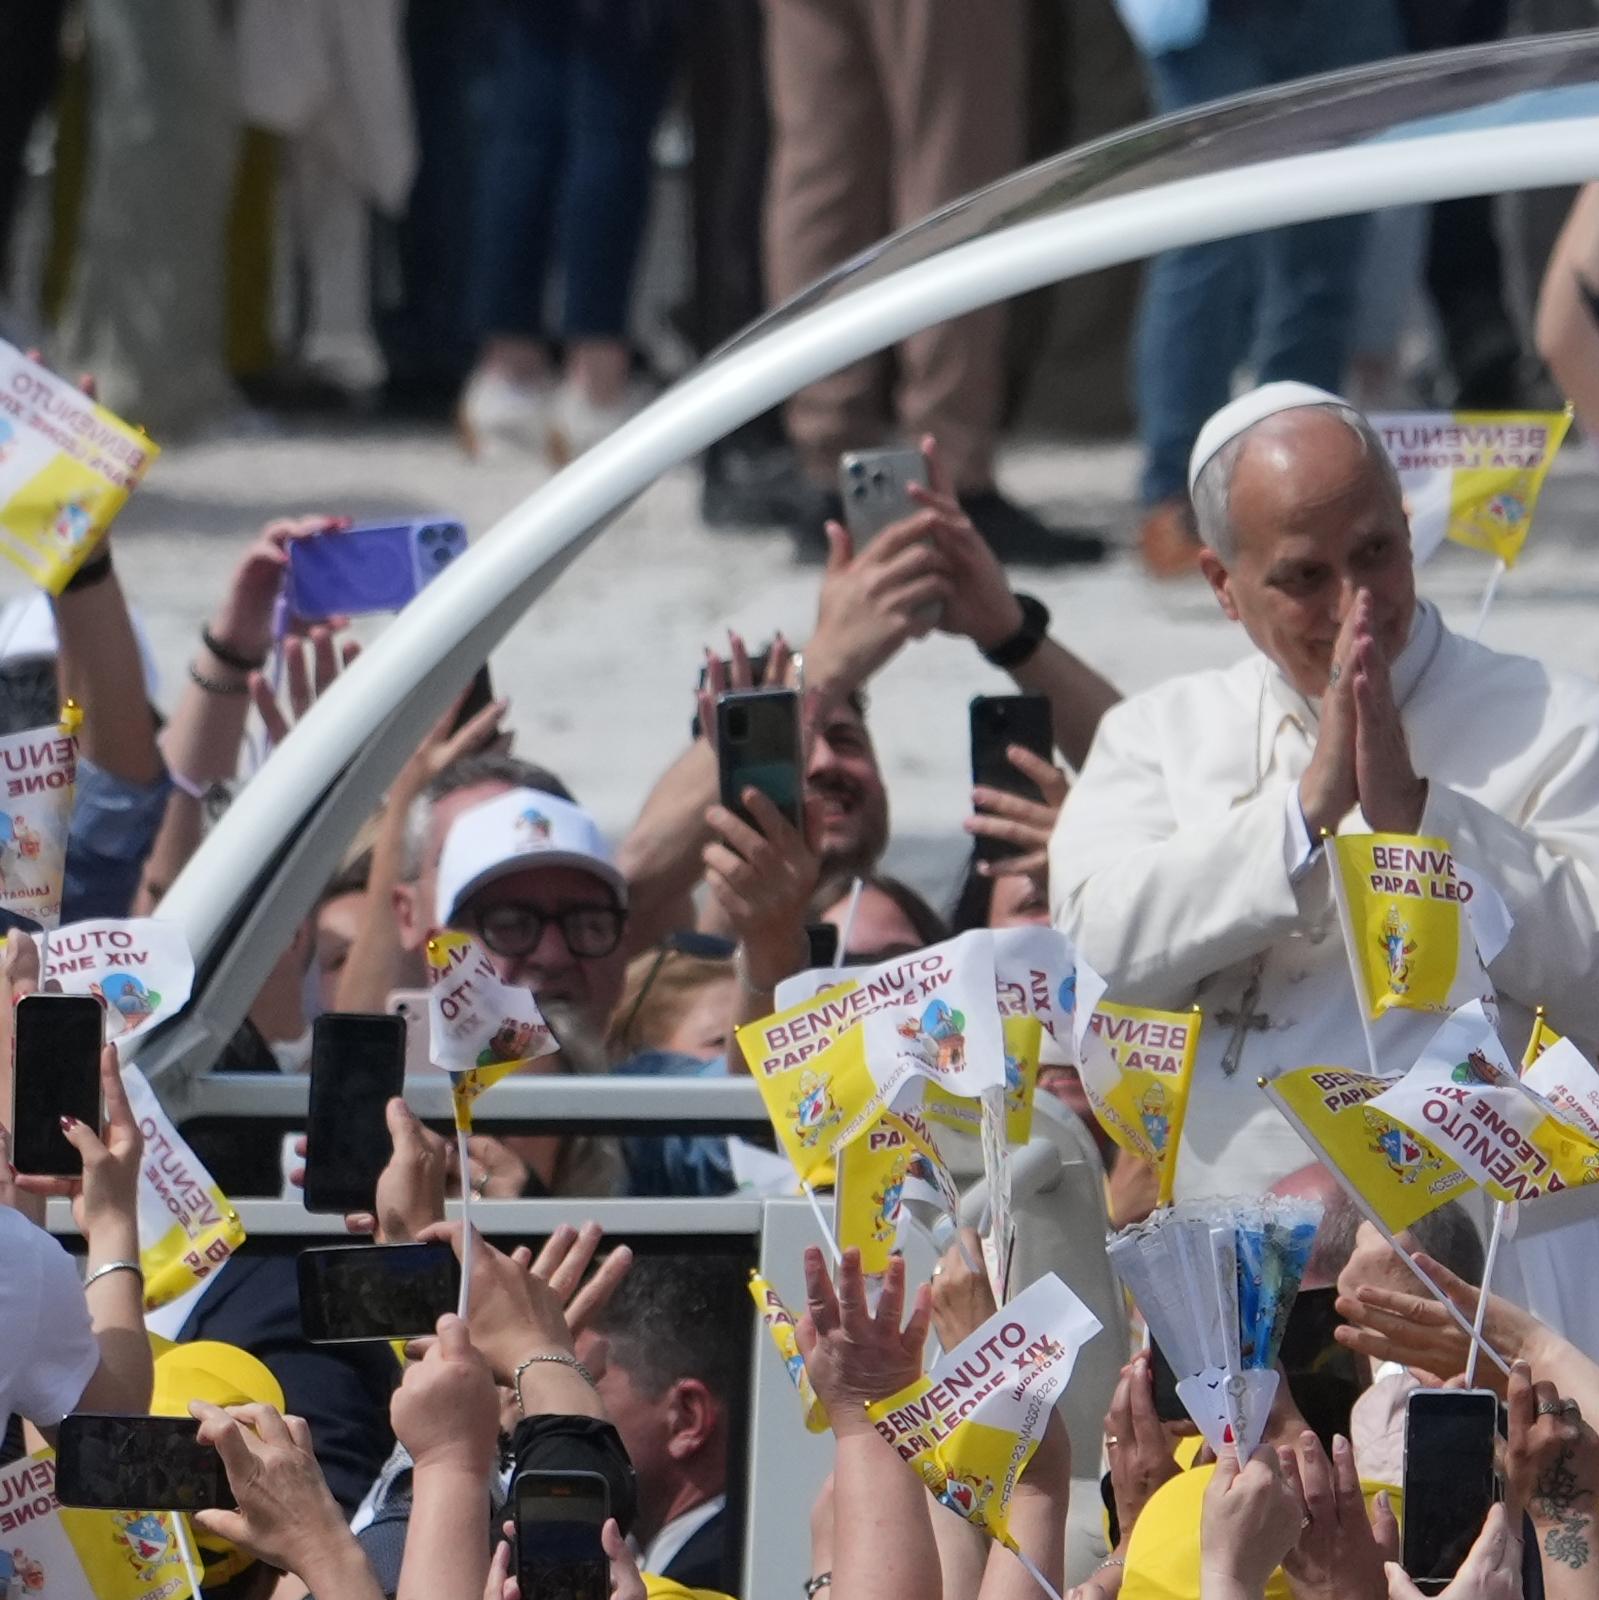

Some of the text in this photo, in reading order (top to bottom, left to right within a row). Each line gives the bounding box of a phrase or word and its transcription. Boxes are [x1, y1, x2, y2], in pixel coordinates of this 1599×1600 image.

[1371, 875, 1473, 903] PAPA LEO
[105, 951, 149, 968] XIV
[763, 1037, 831, 1076] PAPA
[922, 969, 954, 998] XIV
[765, 955, 944, 1052] BENVENUTO
[1470, 1099, 1548, 1175] LEONE
[1012, 1333, 1053, 1372] XIV
[874, 1322, 1026, 1444] BENVENUTO
[1012, 1440, 1026, 1461] 23
